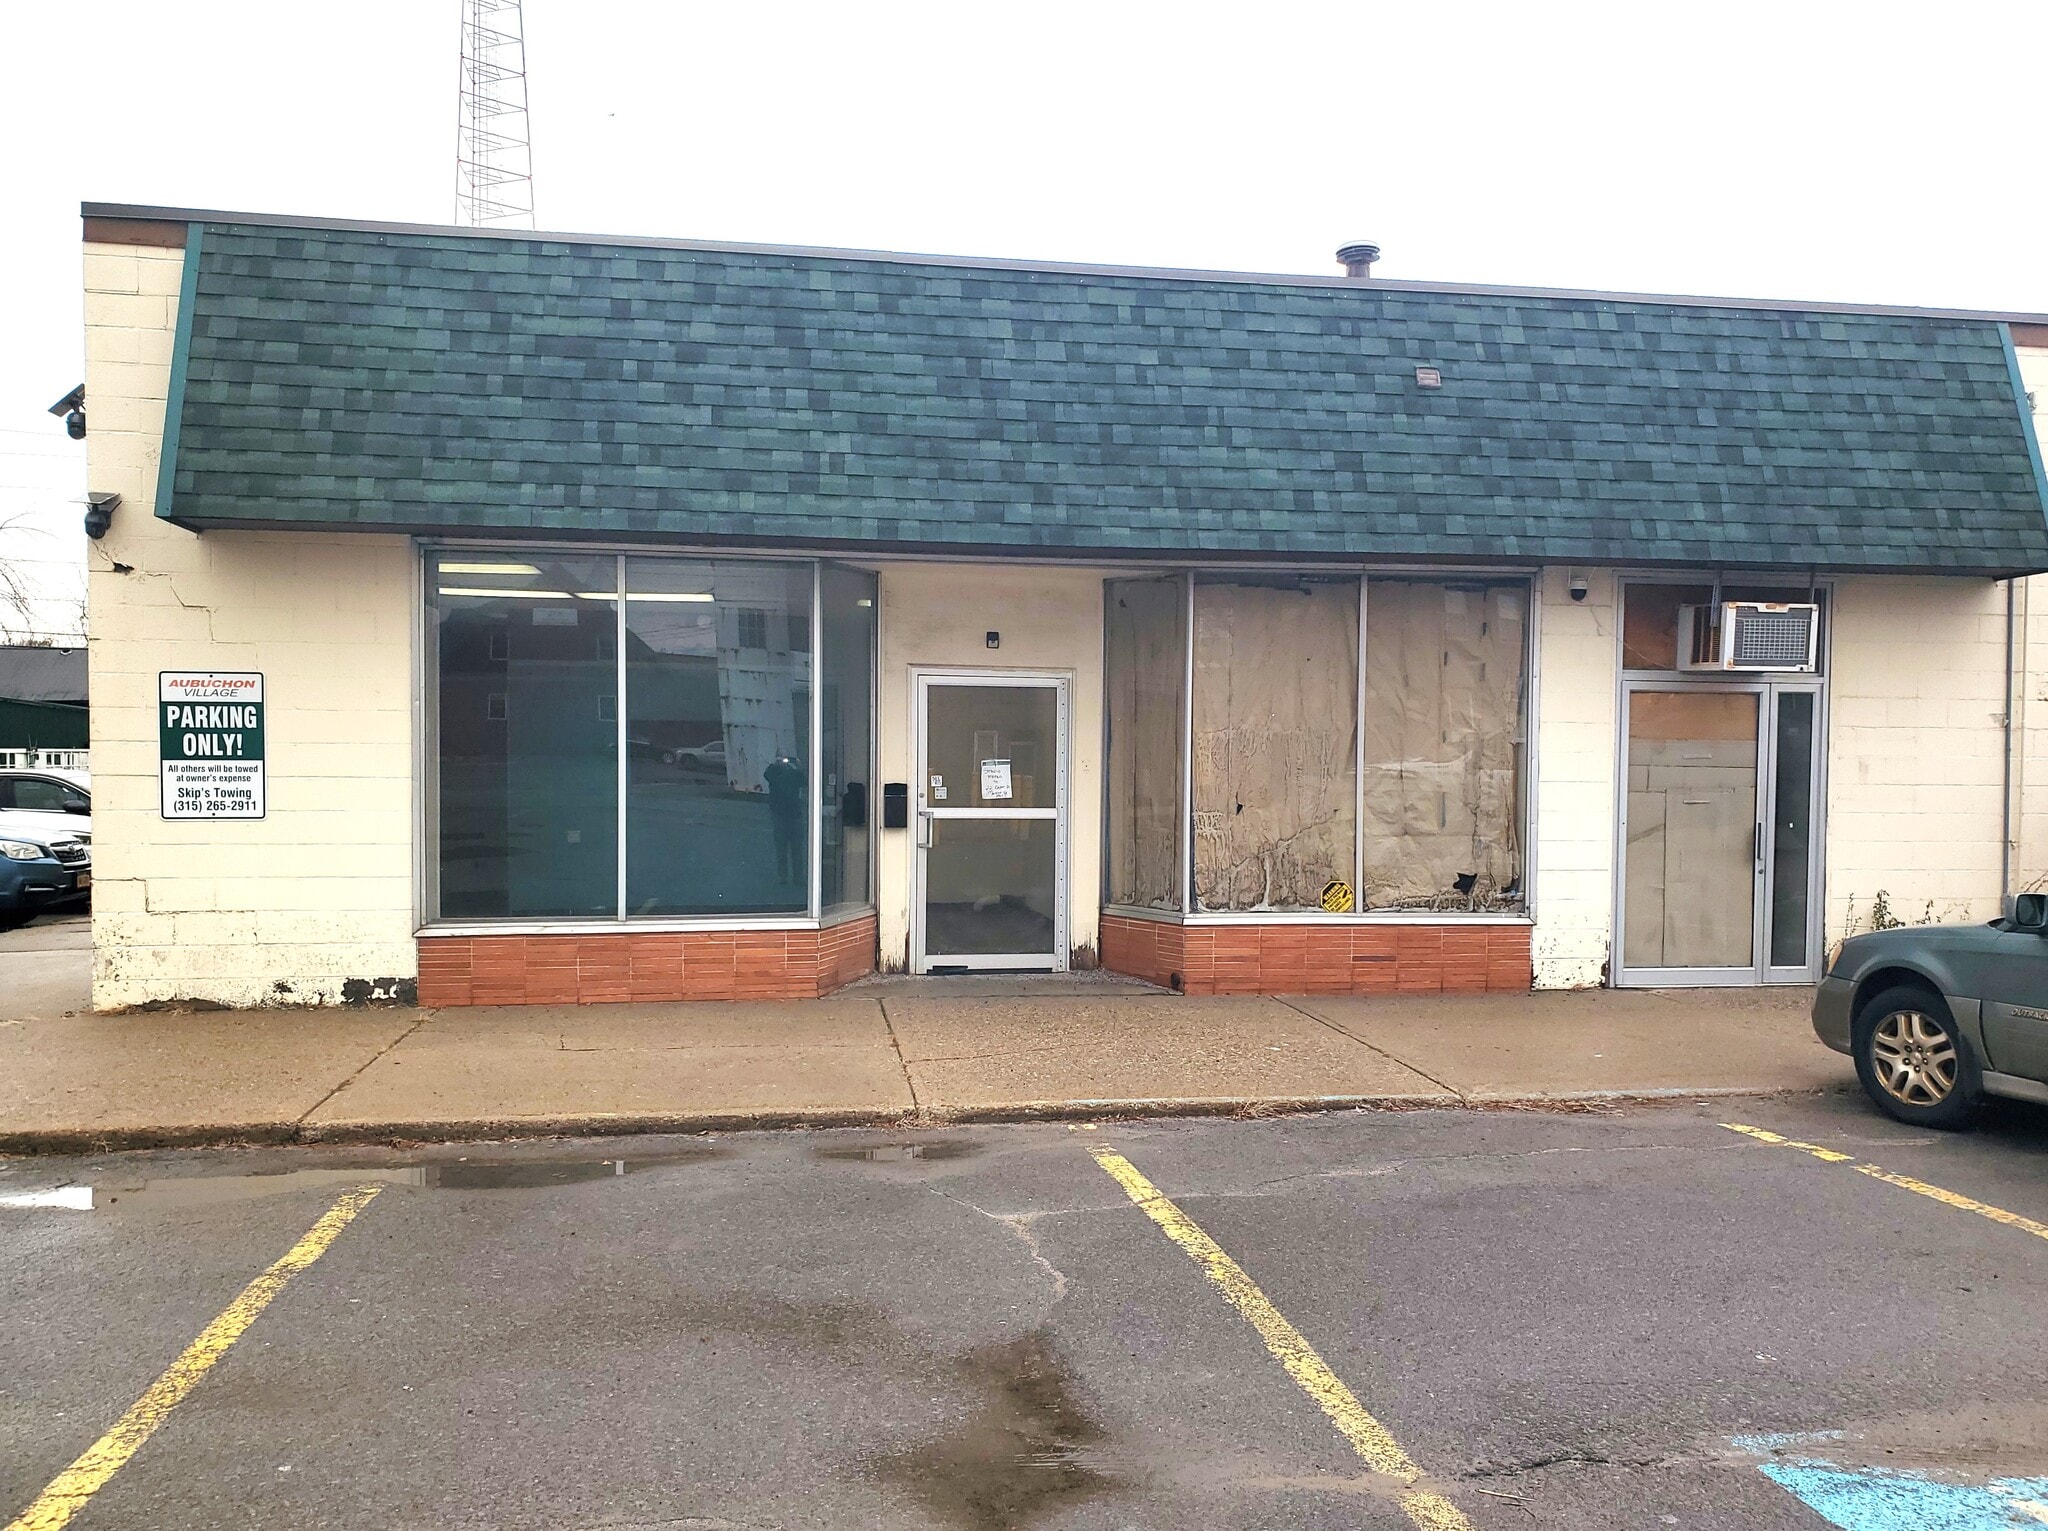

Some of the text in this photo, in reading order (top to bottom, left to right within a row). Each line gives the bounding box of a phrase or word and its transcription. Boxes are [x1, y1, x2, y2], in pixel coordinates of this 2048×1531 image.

[169, 679, 255, 688] AUBUCHON
[185, 689, 239, 697] VILLAGE
[167, 706, 257, 728] PARKING
[182, 733, 243, 756] ONLY!
[181, 765, 205, 773] others
[186, 774, 217, 782] owner's
[219, 775, 251, 783] expense
[178, 788, 251, 800] Skip's Towing
[174, 801, 256, 813] (315) 265-2911
